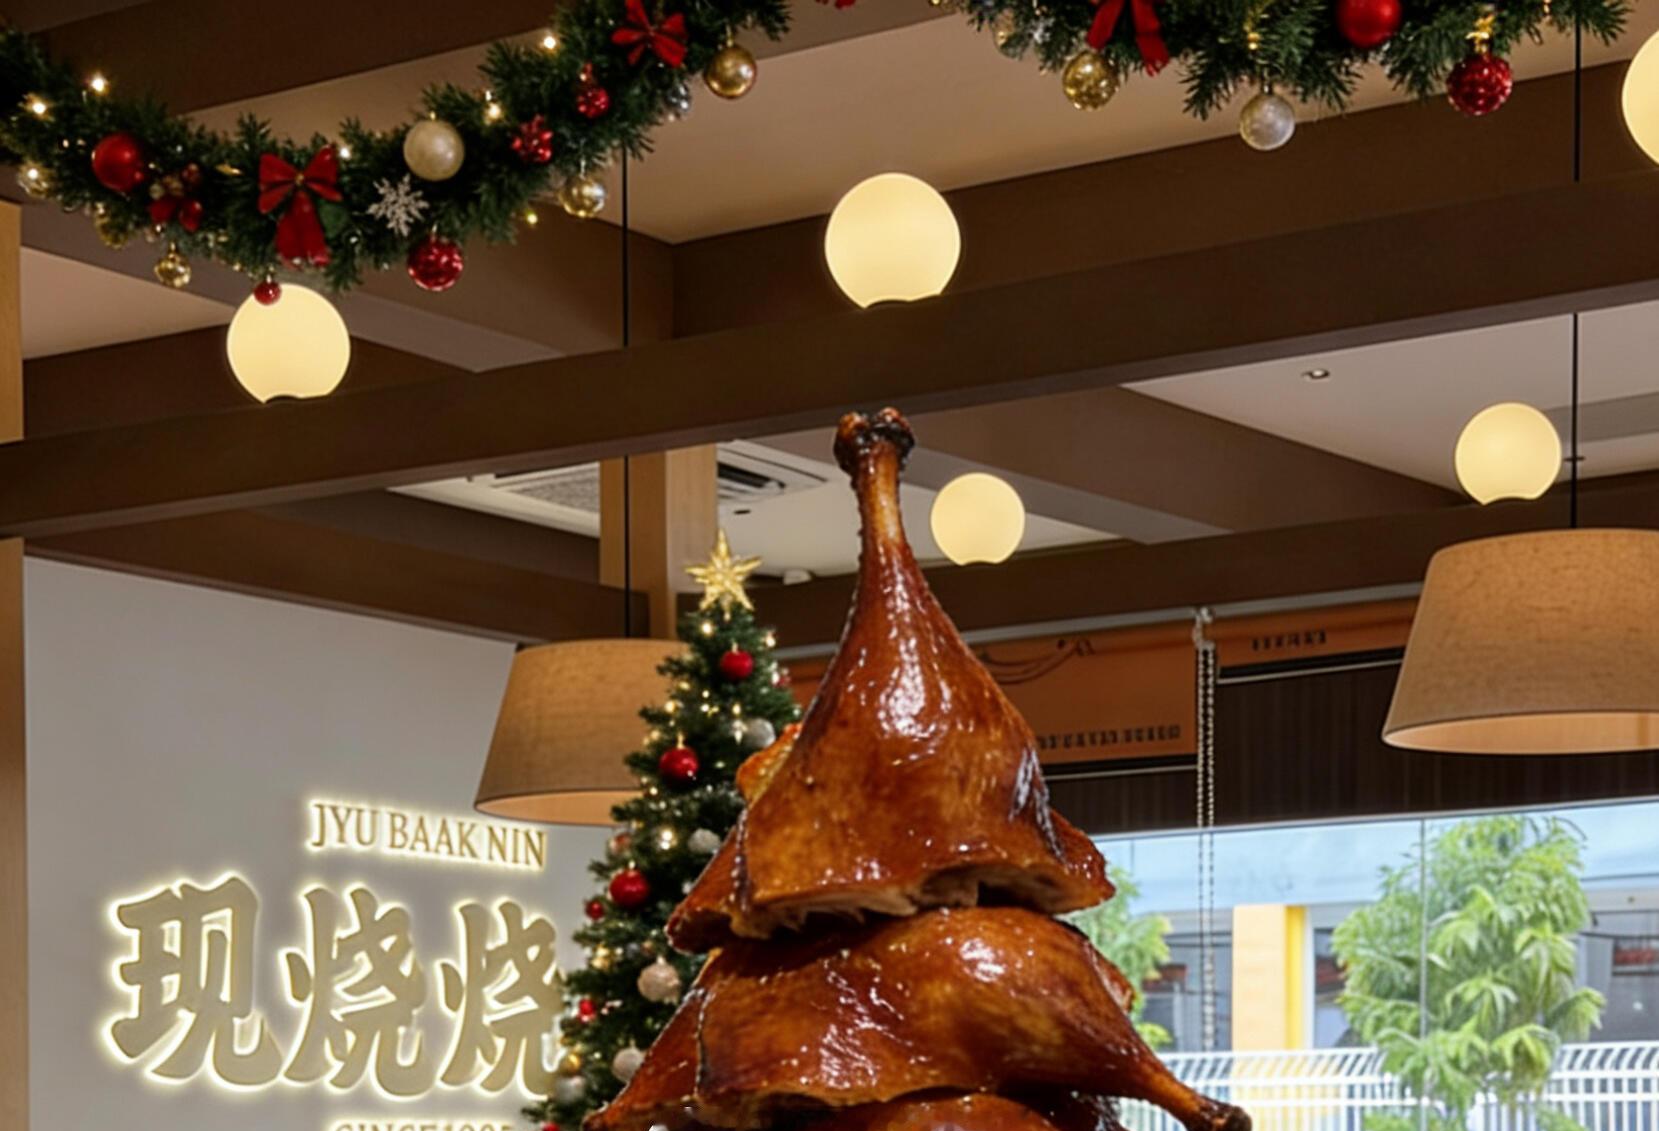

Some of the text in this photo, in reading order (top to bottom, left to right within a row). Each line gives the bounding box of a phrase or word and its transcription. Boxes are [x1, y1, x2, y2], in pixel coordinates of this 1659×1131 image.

[311, 803, 547, 868] JYU BAAK NIN
[112, 873, 564, 1098] 现烧烧
